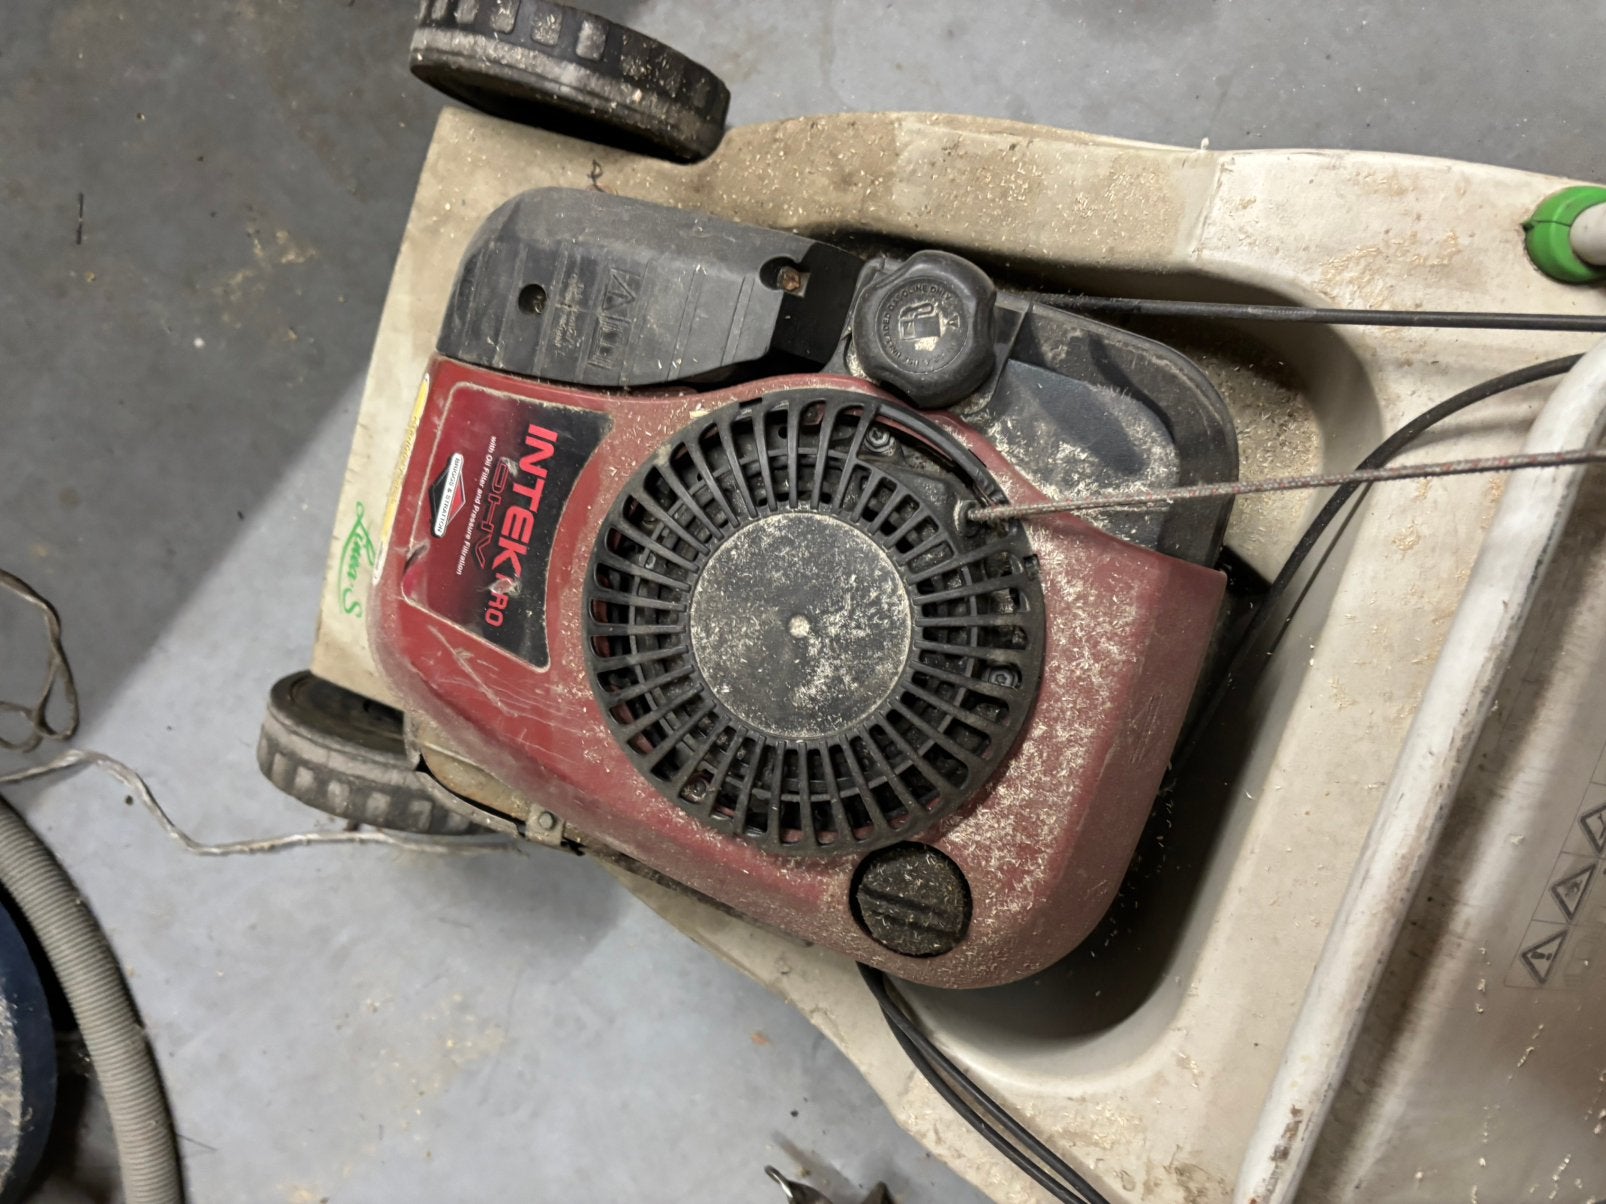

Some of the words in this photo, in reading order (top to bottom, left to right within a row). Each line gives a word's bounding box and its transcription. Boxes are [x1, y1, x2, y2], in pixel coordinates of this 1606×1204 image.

[484, 454, 494, 467] Oil
[487, 435, 497, 454] with
[449, 457, 461, 487] BRIGGS
[479, 466, 491, 489] Filter
[437, 494, 453, 532] STRATTON
[474, 489, 483, 505] and
[491, 423, 559, 577] INTEK
[464, 503, 480, 540] Pressure
[475, 460, 511, 570] OHV
[456, 539, 472, 576] Filtration
